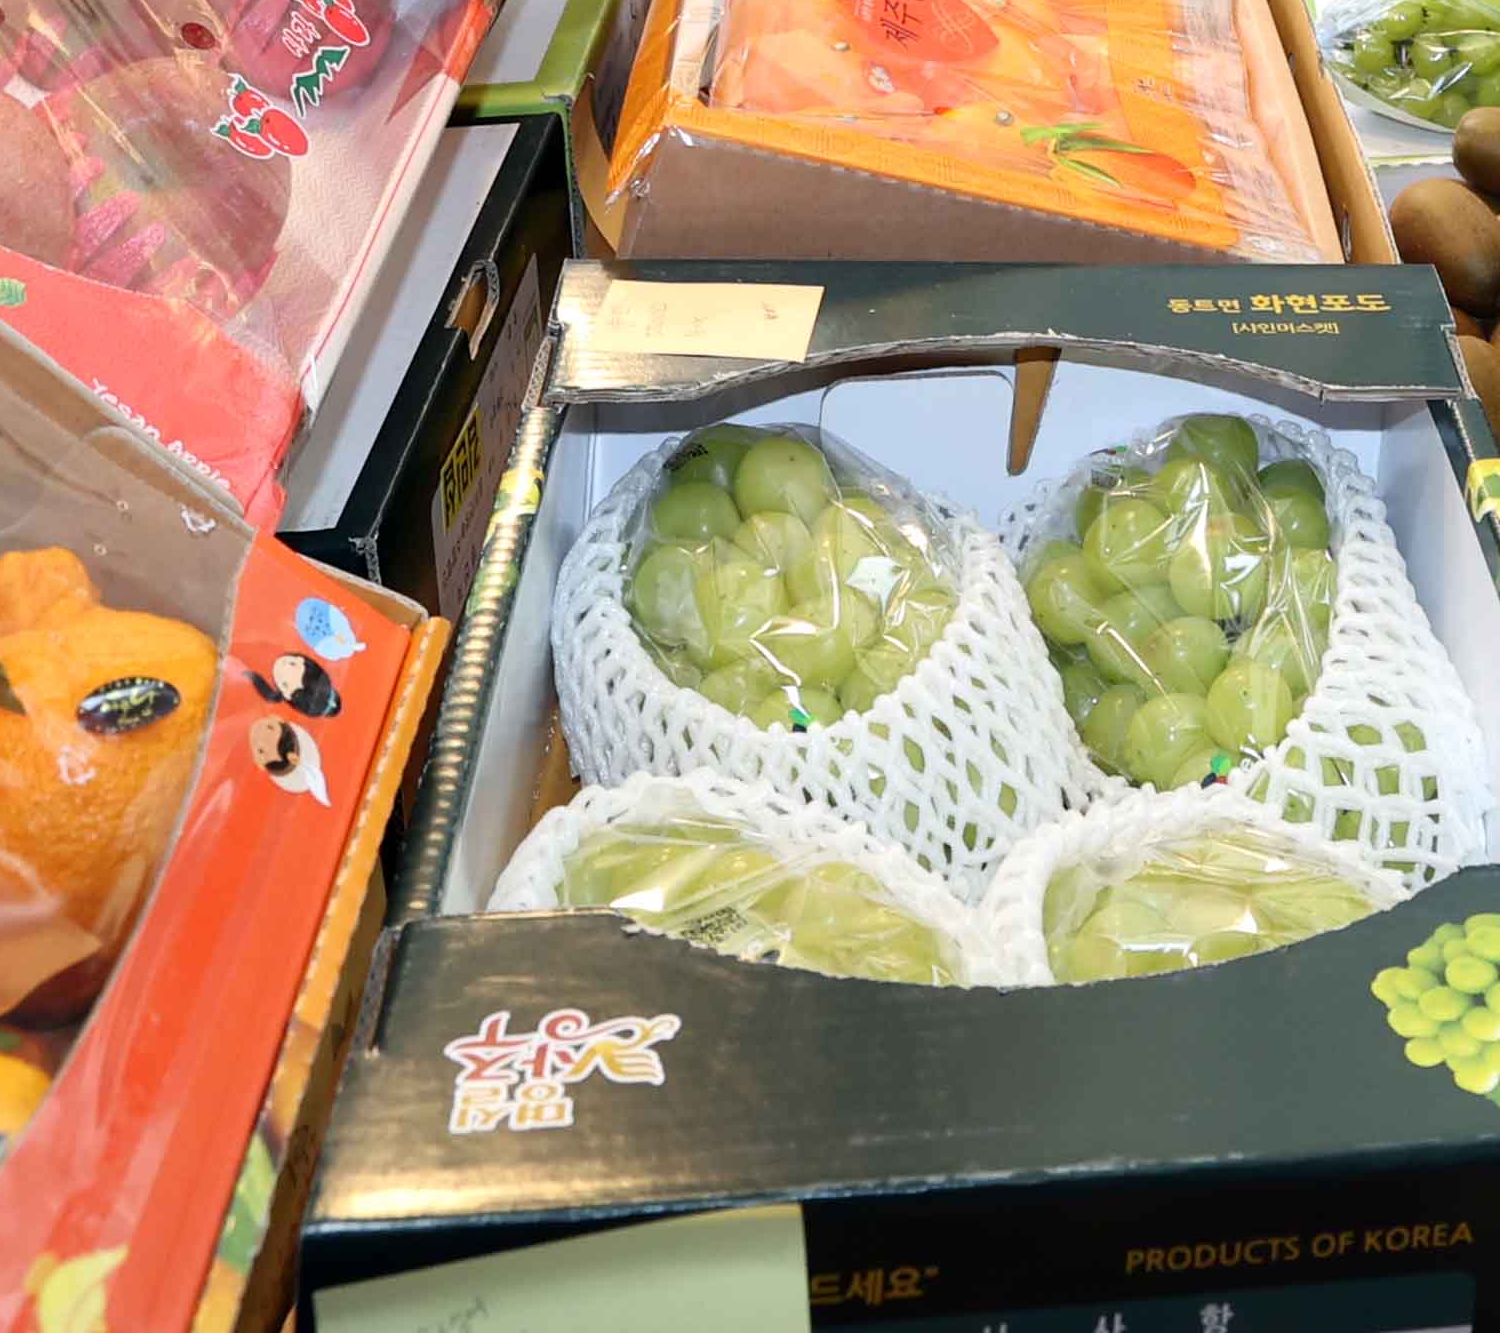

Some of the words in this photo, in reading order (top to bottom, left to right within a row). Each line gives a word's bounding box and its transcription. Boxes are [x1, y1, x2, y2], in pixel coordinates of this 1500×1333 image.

[1250, 293, 1393, 315] 화현포도
[1124, 1235, 1301, 1276] PRODUCTS
[1310, 1231, 1357, 1259] OF
[1363, 1220, 1477, 1254] KOREA
